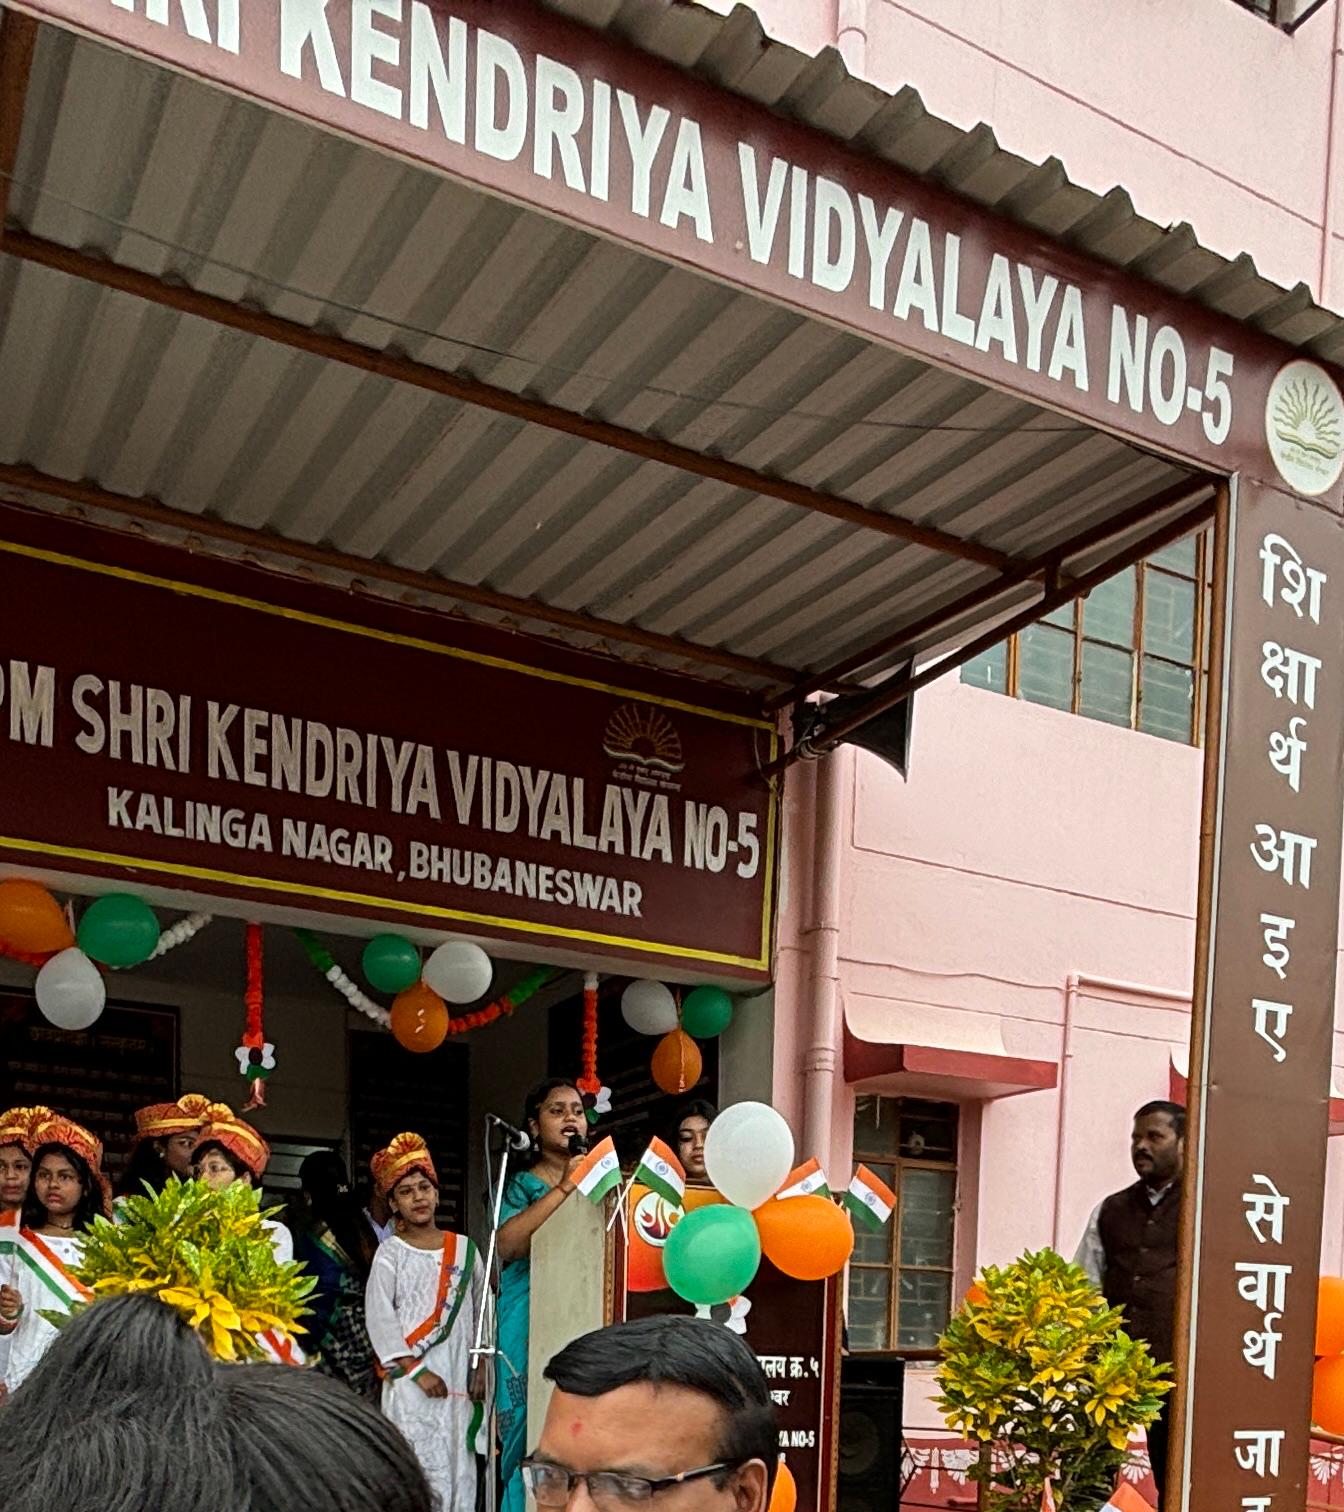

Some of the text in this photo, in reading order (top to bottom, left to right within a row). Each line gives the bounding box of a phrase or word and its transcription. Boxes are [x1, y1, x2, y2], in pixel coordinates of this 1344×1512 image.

[281, 0, 1234, 446] KENDRIYA VIDYALAYA NO-5
[72, 674, 191, 774] SHRI
[207, 700, 442, 821] KENDRIYA
[447, 750, 673, 864] VIDYALAYA
[684, 800, 759, 878] NO-5
[107, 786, 273, 853] KALINGA
